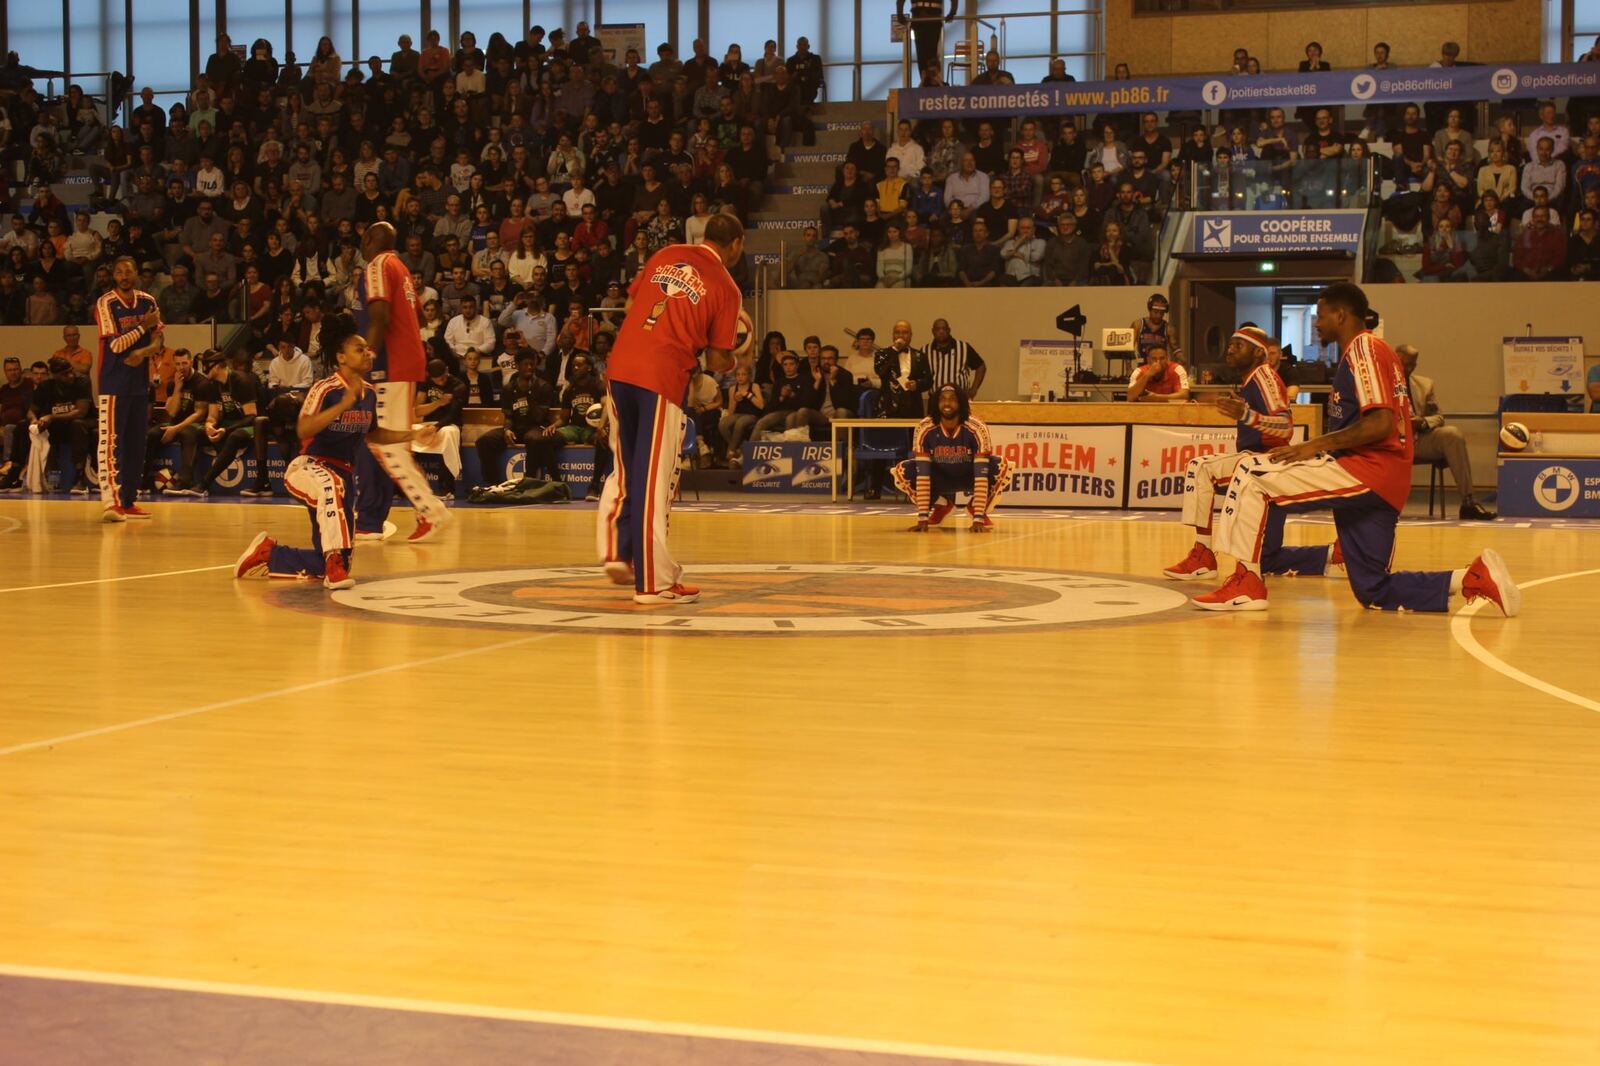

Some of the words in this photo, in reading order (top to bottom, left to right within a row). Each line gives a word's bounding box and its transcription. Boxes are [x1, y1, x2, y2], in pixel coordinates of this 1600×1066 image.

[1380, 78, 1453, 94] @pb86officiel
[1521, 73, 1596, 89] @pb86officiel
[919, 93, 965, 111] restez
[970, 89, 1049, 109] connectés
[1055, 90, 1060, 106] !
[1065, 86, 1170, 107] www.pb86.fr
[1228, 83, 1317, 99] /poitiersbasket86
[1260, 216, 1331, 233] COOPÉRER
[1233, 234, 1260, 244] POUR
[1263, 233, 1307, 243] GRANDIR
[1310, 233, 1359, 243] ENSEMBLE
[662, 264, 704, 292] HARLEM
[651, 274, 701, 304] GLOBETROTTERS
[1016, 432, 1031, 440] THE
[1033, 431, 1069, 441] ORIGINAL
[1191, 432, 1207, 442] THE
[752, 446, 783, 460] IRIS
[801, 446, 832, 461] IRIS
[1538, 467, 1576, 481] BMW
